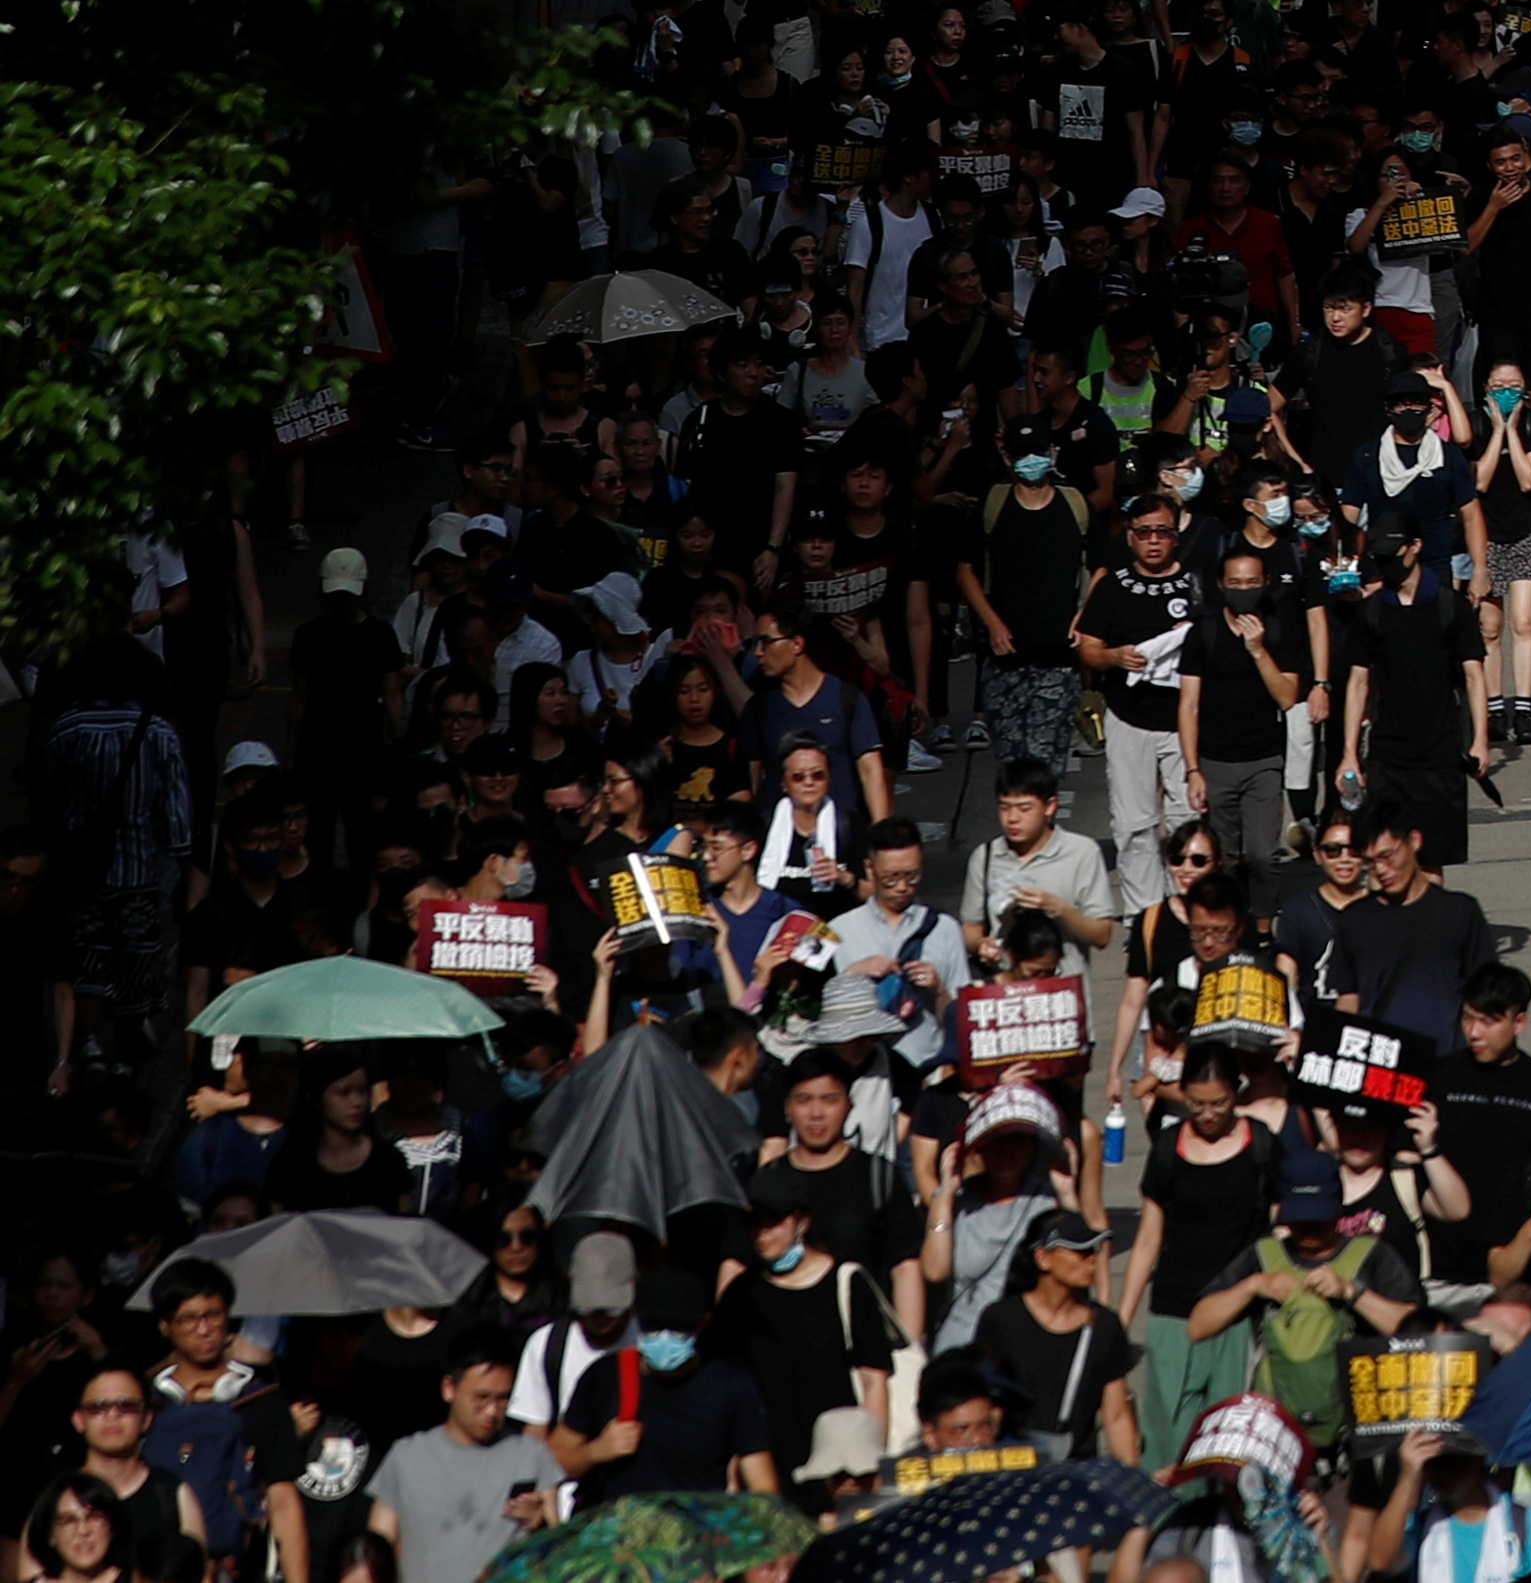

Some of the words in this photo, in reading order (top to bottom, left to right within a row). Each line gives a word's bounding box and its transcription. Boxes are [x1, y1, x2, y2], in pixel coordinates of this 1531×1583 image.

[1064, 116, 1098, 128] adidas
[938, 155, 1012, 174] 平反暴動
[1383, 217, 1460, 242] 送中惡法
[432, 910, 535, 944] 平反暴動
[430, 940, 535, 973] 撤銷檢控
[1198, 963, 1288, 1003] 全面撤回
[967, 988, 1080, 1030] 平反暴動
[970, 1020, 1082, 1060] 撤銷檢控
[1336, 1024, 1402, 1071] 反對
[1297, 1050, 1428, 1109] 林鄭暴政
[1348, 1350, 1479, 1392] 全面撤回
[1349, 1386, 1477, 1426] 送中惡法
[895, 1445, 1038, 1482] 全面撤回
